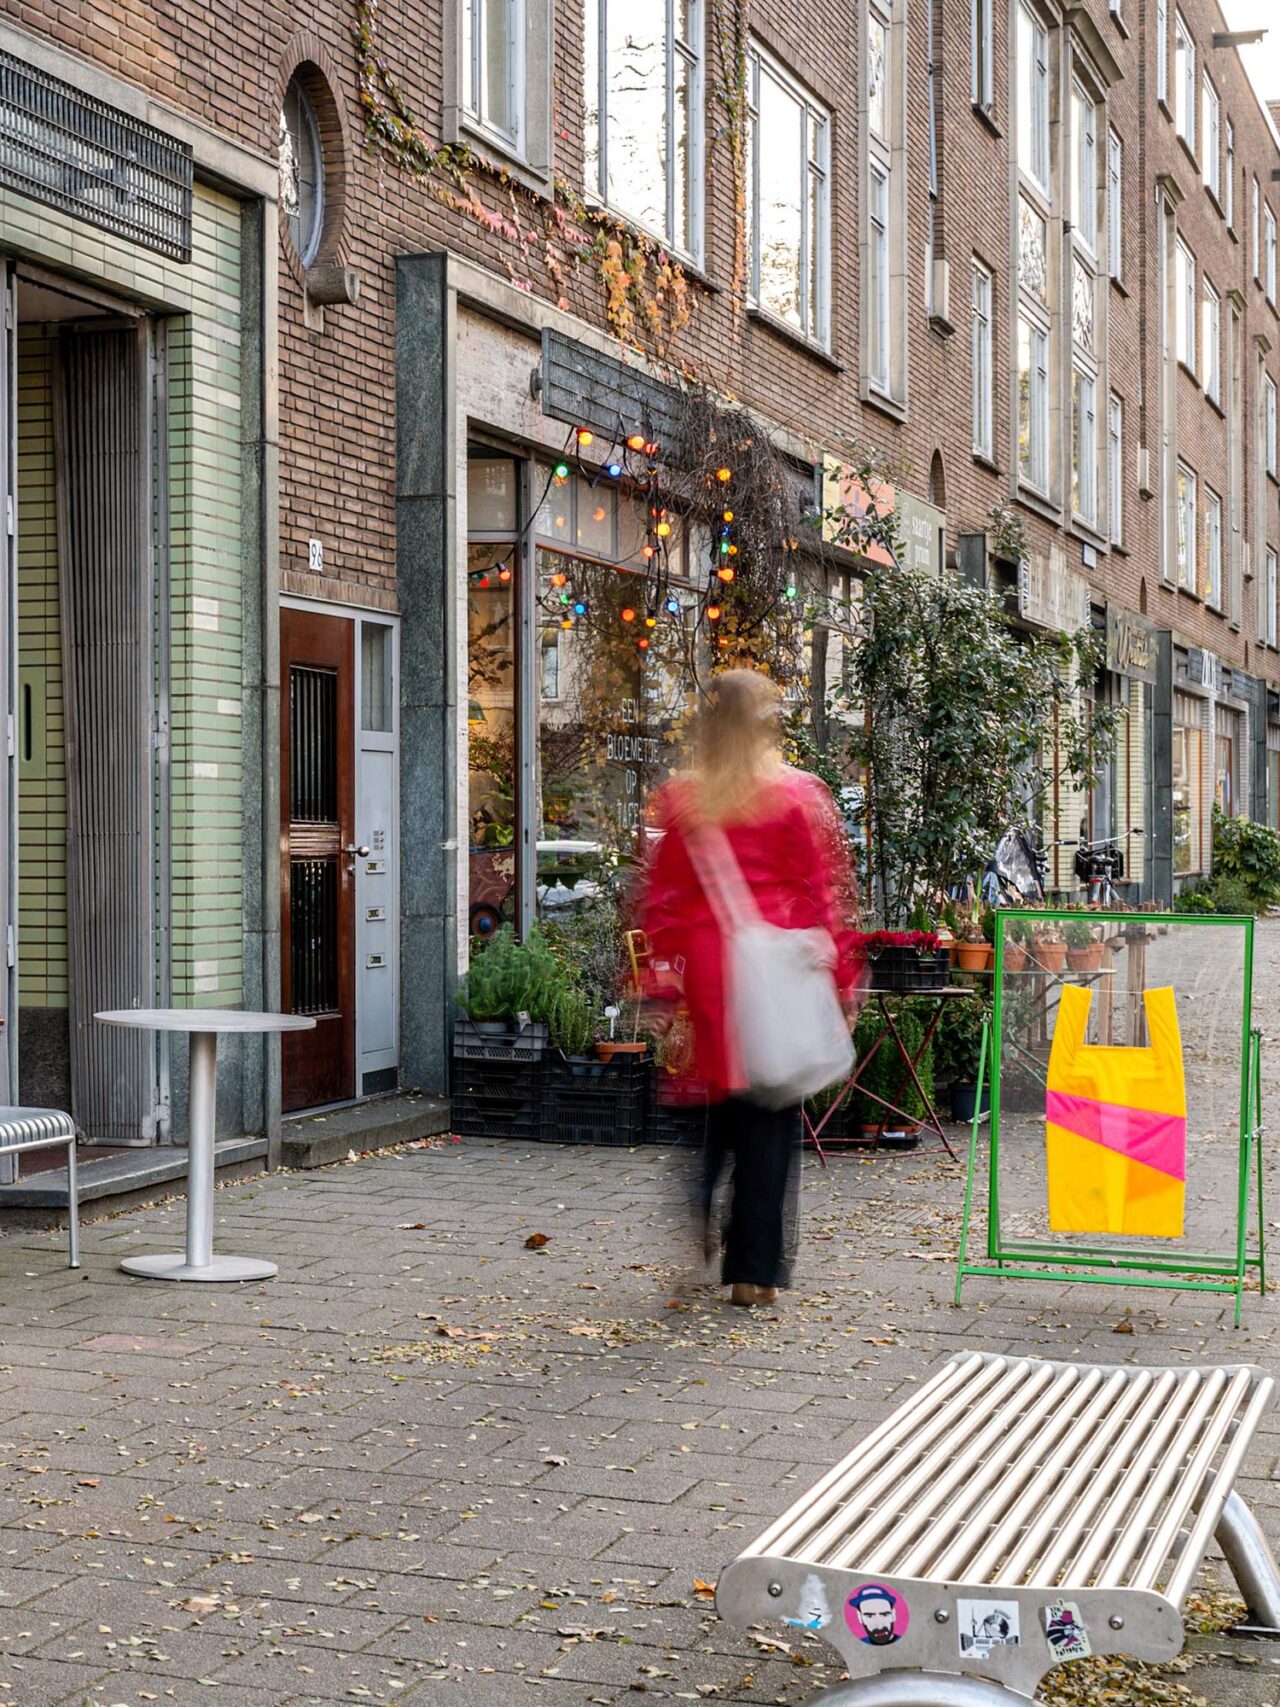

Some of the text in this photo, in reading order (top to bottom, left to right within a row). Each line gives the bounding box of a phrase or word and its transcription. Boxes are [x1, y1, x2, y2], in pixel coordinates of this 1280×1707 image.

[312, 543, 323, 567] 96
[607, 734, 659, 763] BLOEMETJE
[625, 769, 637, 794] OP
